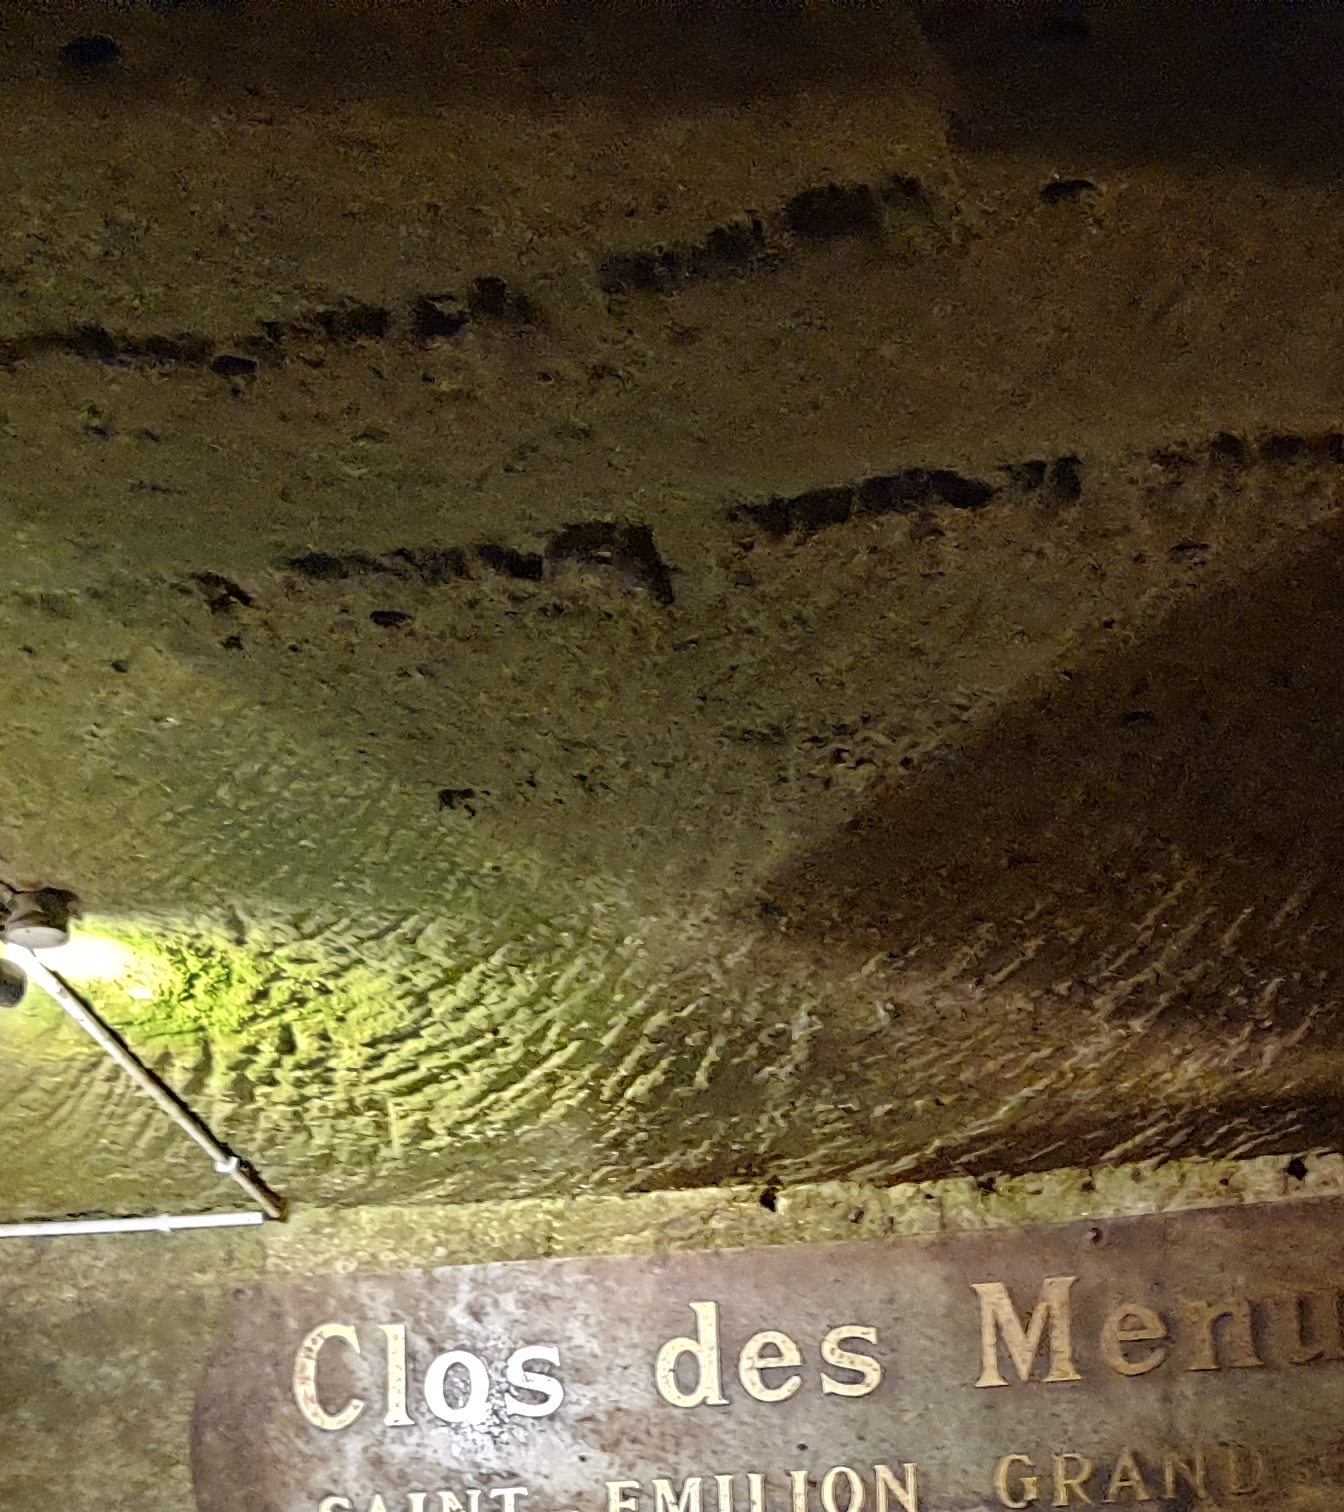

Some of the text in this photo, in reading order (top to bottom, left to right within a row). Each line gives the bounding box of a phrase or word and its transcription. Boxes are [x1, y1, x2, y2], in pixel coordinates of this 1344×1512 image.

[293, 1322, 565, 1431] Clos
[655, 1301, 885, 1409] des
[992, 1440, 1264, 1510] GRAND
